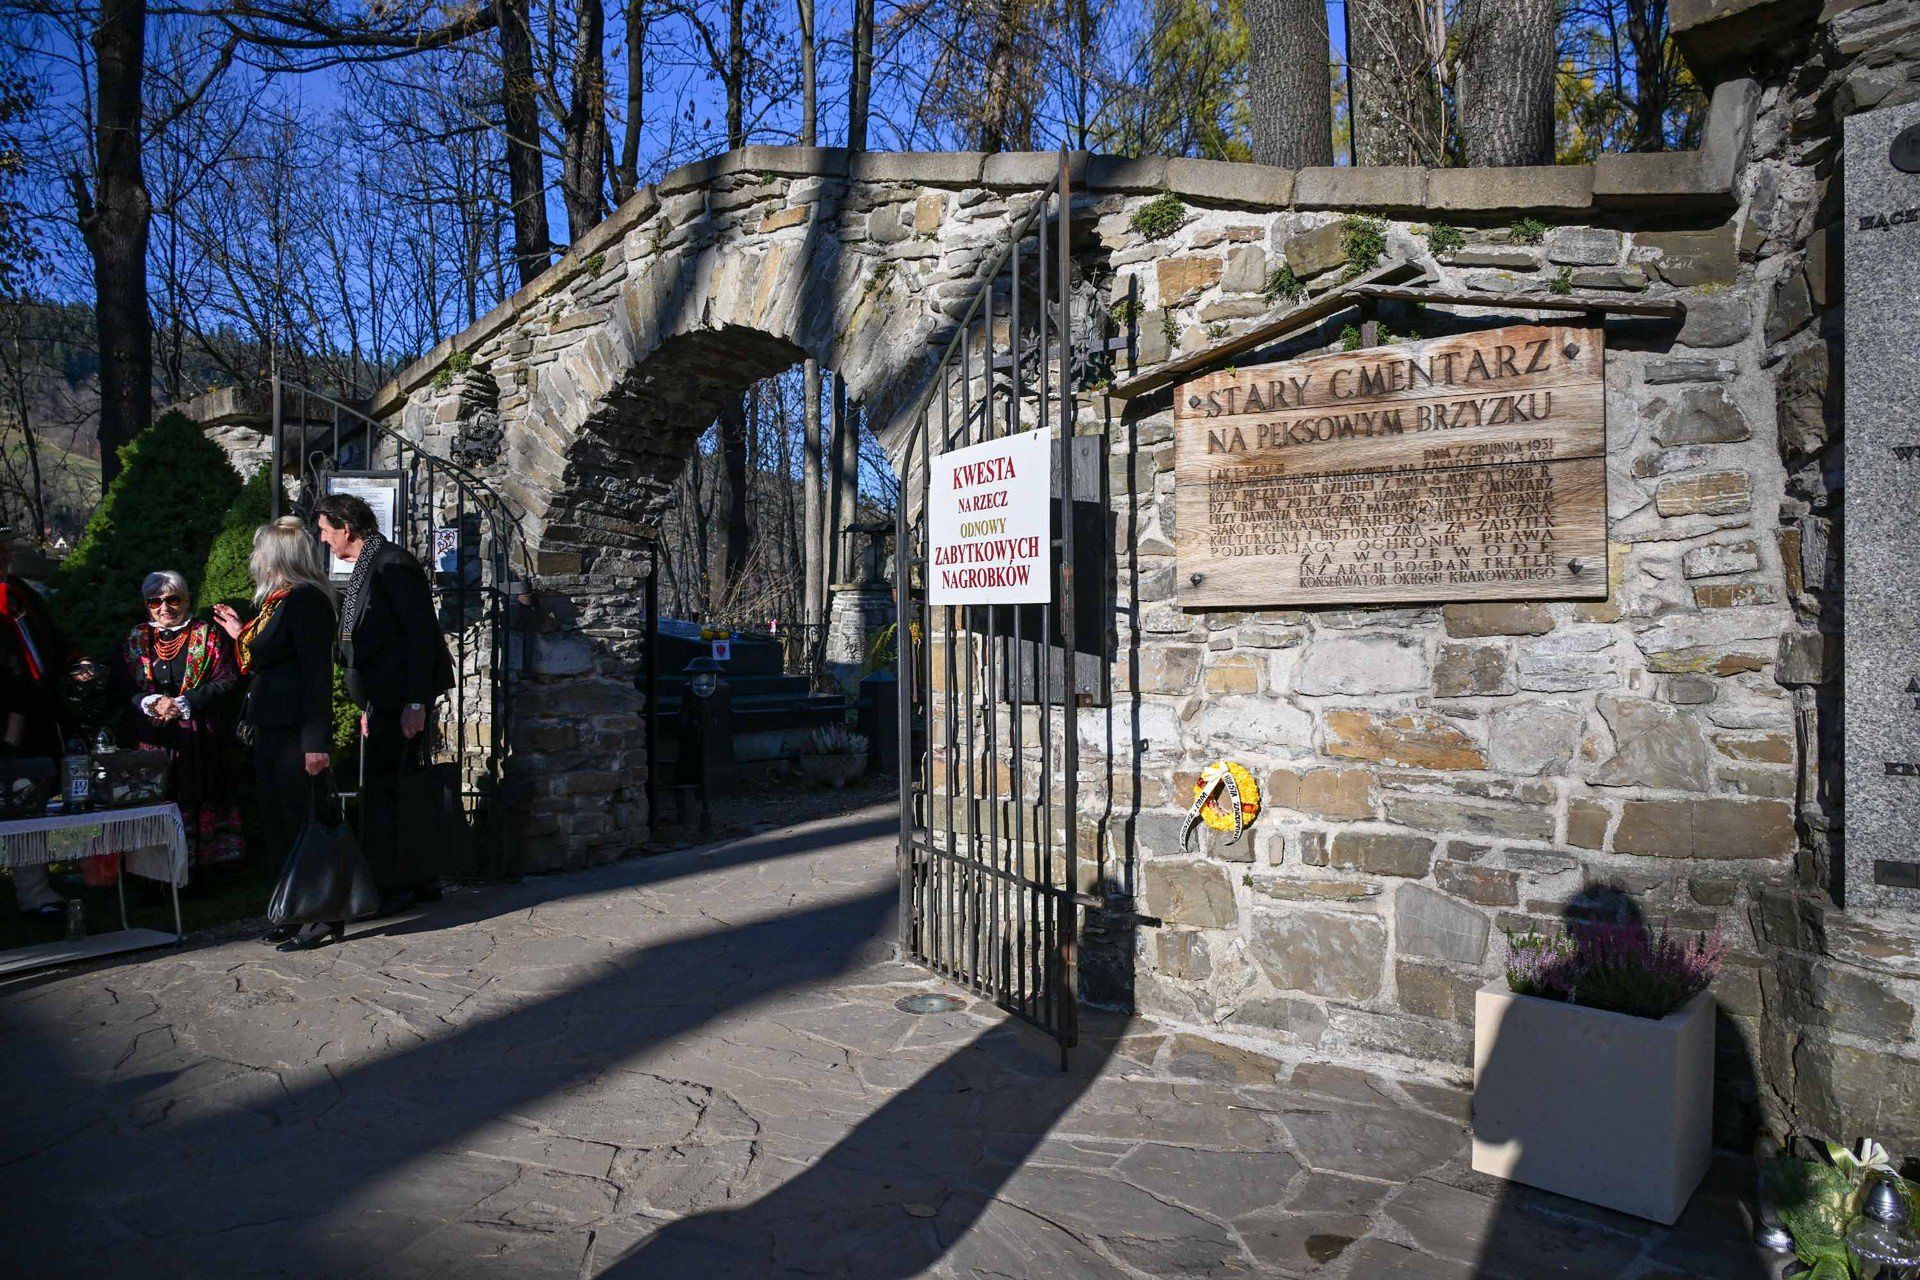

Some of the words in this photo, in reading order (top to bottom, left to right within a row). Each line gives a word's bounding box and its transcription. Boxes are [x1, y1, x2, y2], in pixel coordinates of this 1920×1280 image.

[1205, 373, 1312, 419] STARY
[1328, 339, 1552, 400] CMENTARZ
[1206, 425, 1246, 456] NA
[1415, 391, 1553, 431] BRZYZKU
[1469, 440, 1522, 457] GRUDNIA
[953, 456, 1015, 490] KWESTA
[958, 498, 971, 513] NA
[973, 490, 1008, 511] RZECZ
[1340, 492, 1365, 505] 265
[1428, 484, 1470, 498] STARY
[1479, 477, 1554, 494] CMENTARZ
[1240, 508, 1291, 522] DAWNYM
[1475, 489, 1555, 507] ZAKOPANEM
[960, 518, 1006, 538] ODNOWY
[1444, 521, 1467, 534] ZA
[1476, 515, 1556, 531] ZABYTEK
[1481, 528, 1556, 544] PRAWA
[935, 536, 1039, 565] ZABYTKOWYCH
[942, 560, 1031, 589] NAGROBKÓW
[1336, 562, 1383, 575] ARCH
[1393, 558, 1470, 573] BOGDAN
[1480, 554, 1556, 569] TRETER
[1299, 573, 1387, 588] KONSERWATOR
[1448, 567, 1557, 583] KRAKOWSKIEGO
